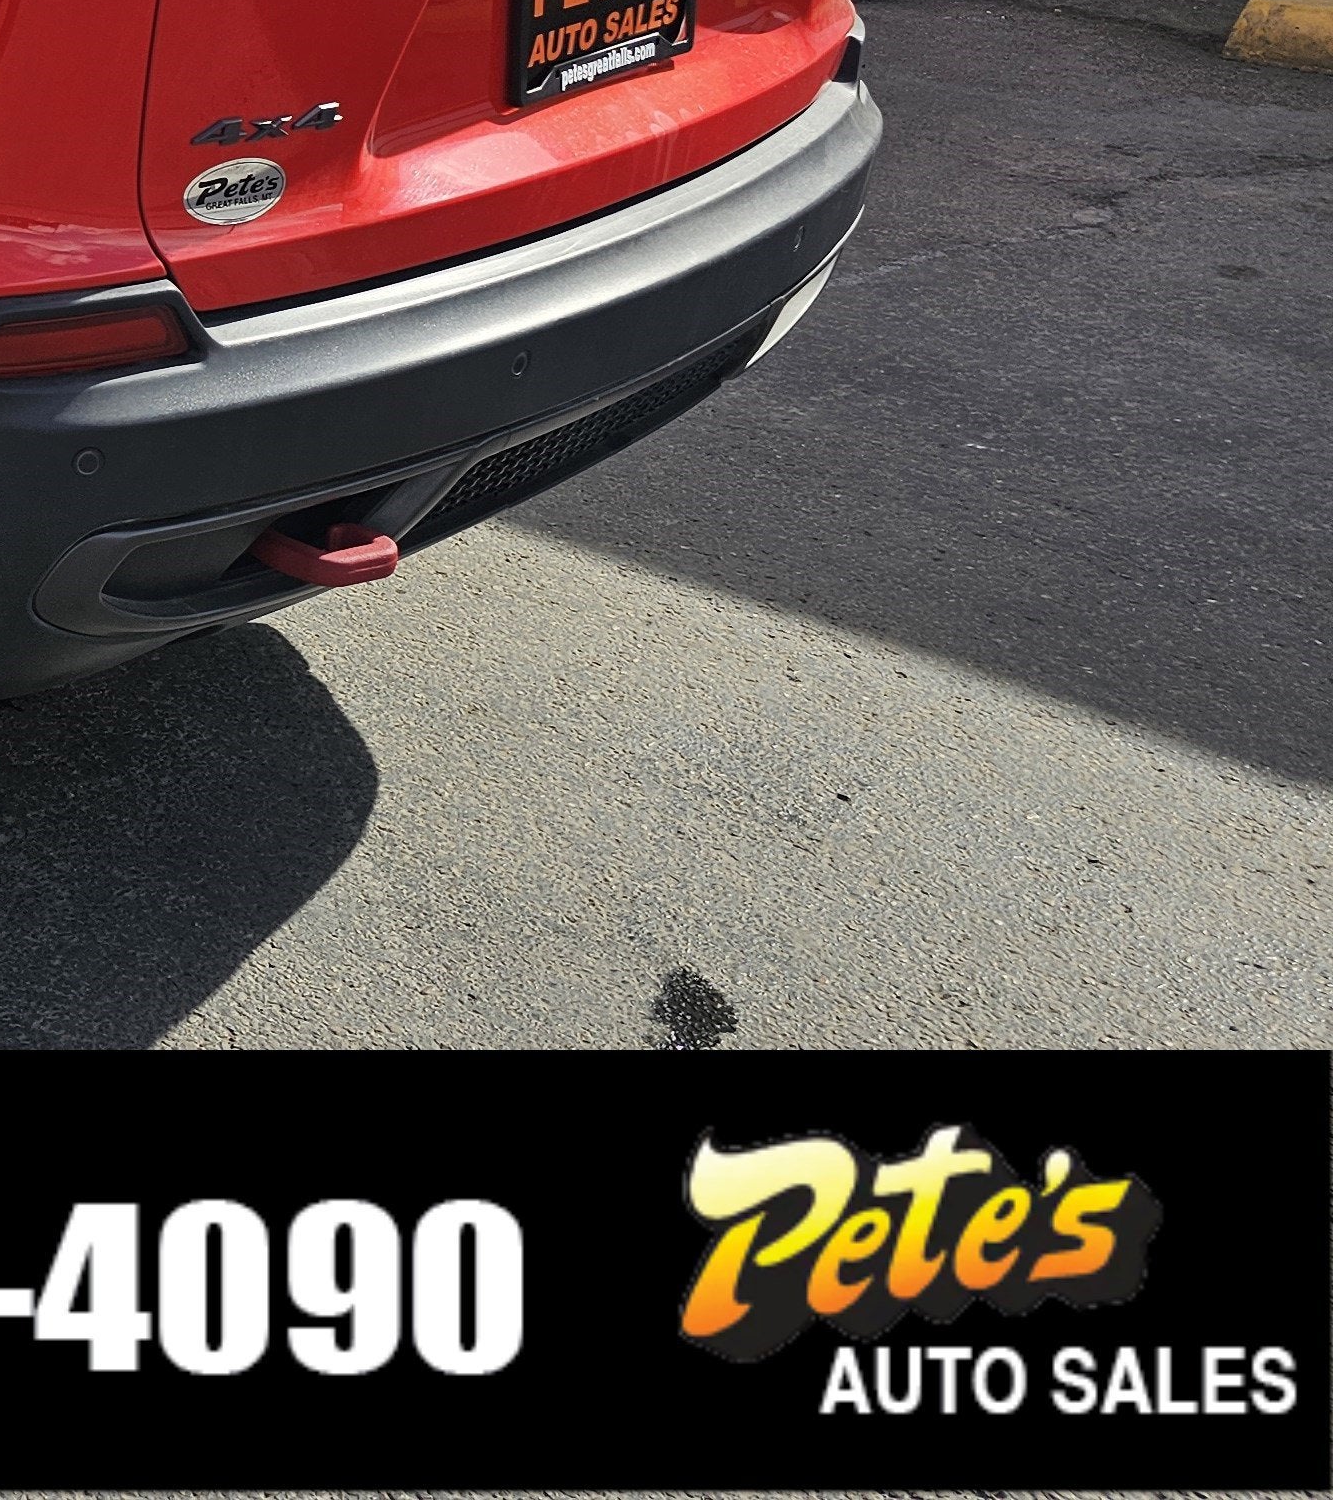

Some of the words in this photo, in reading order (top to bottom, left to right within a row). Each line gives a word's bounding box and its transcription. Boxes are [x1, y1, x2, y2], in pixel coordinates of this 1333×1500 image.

[528, 19, 598, 68] AUTO
[561, 42, 656, 91] petesgreatfalls.com
[190, 102, 343, 146] 4x4
[196, 174, 280, 206] Pete's
[206, 199, 233, 210] GREAT
